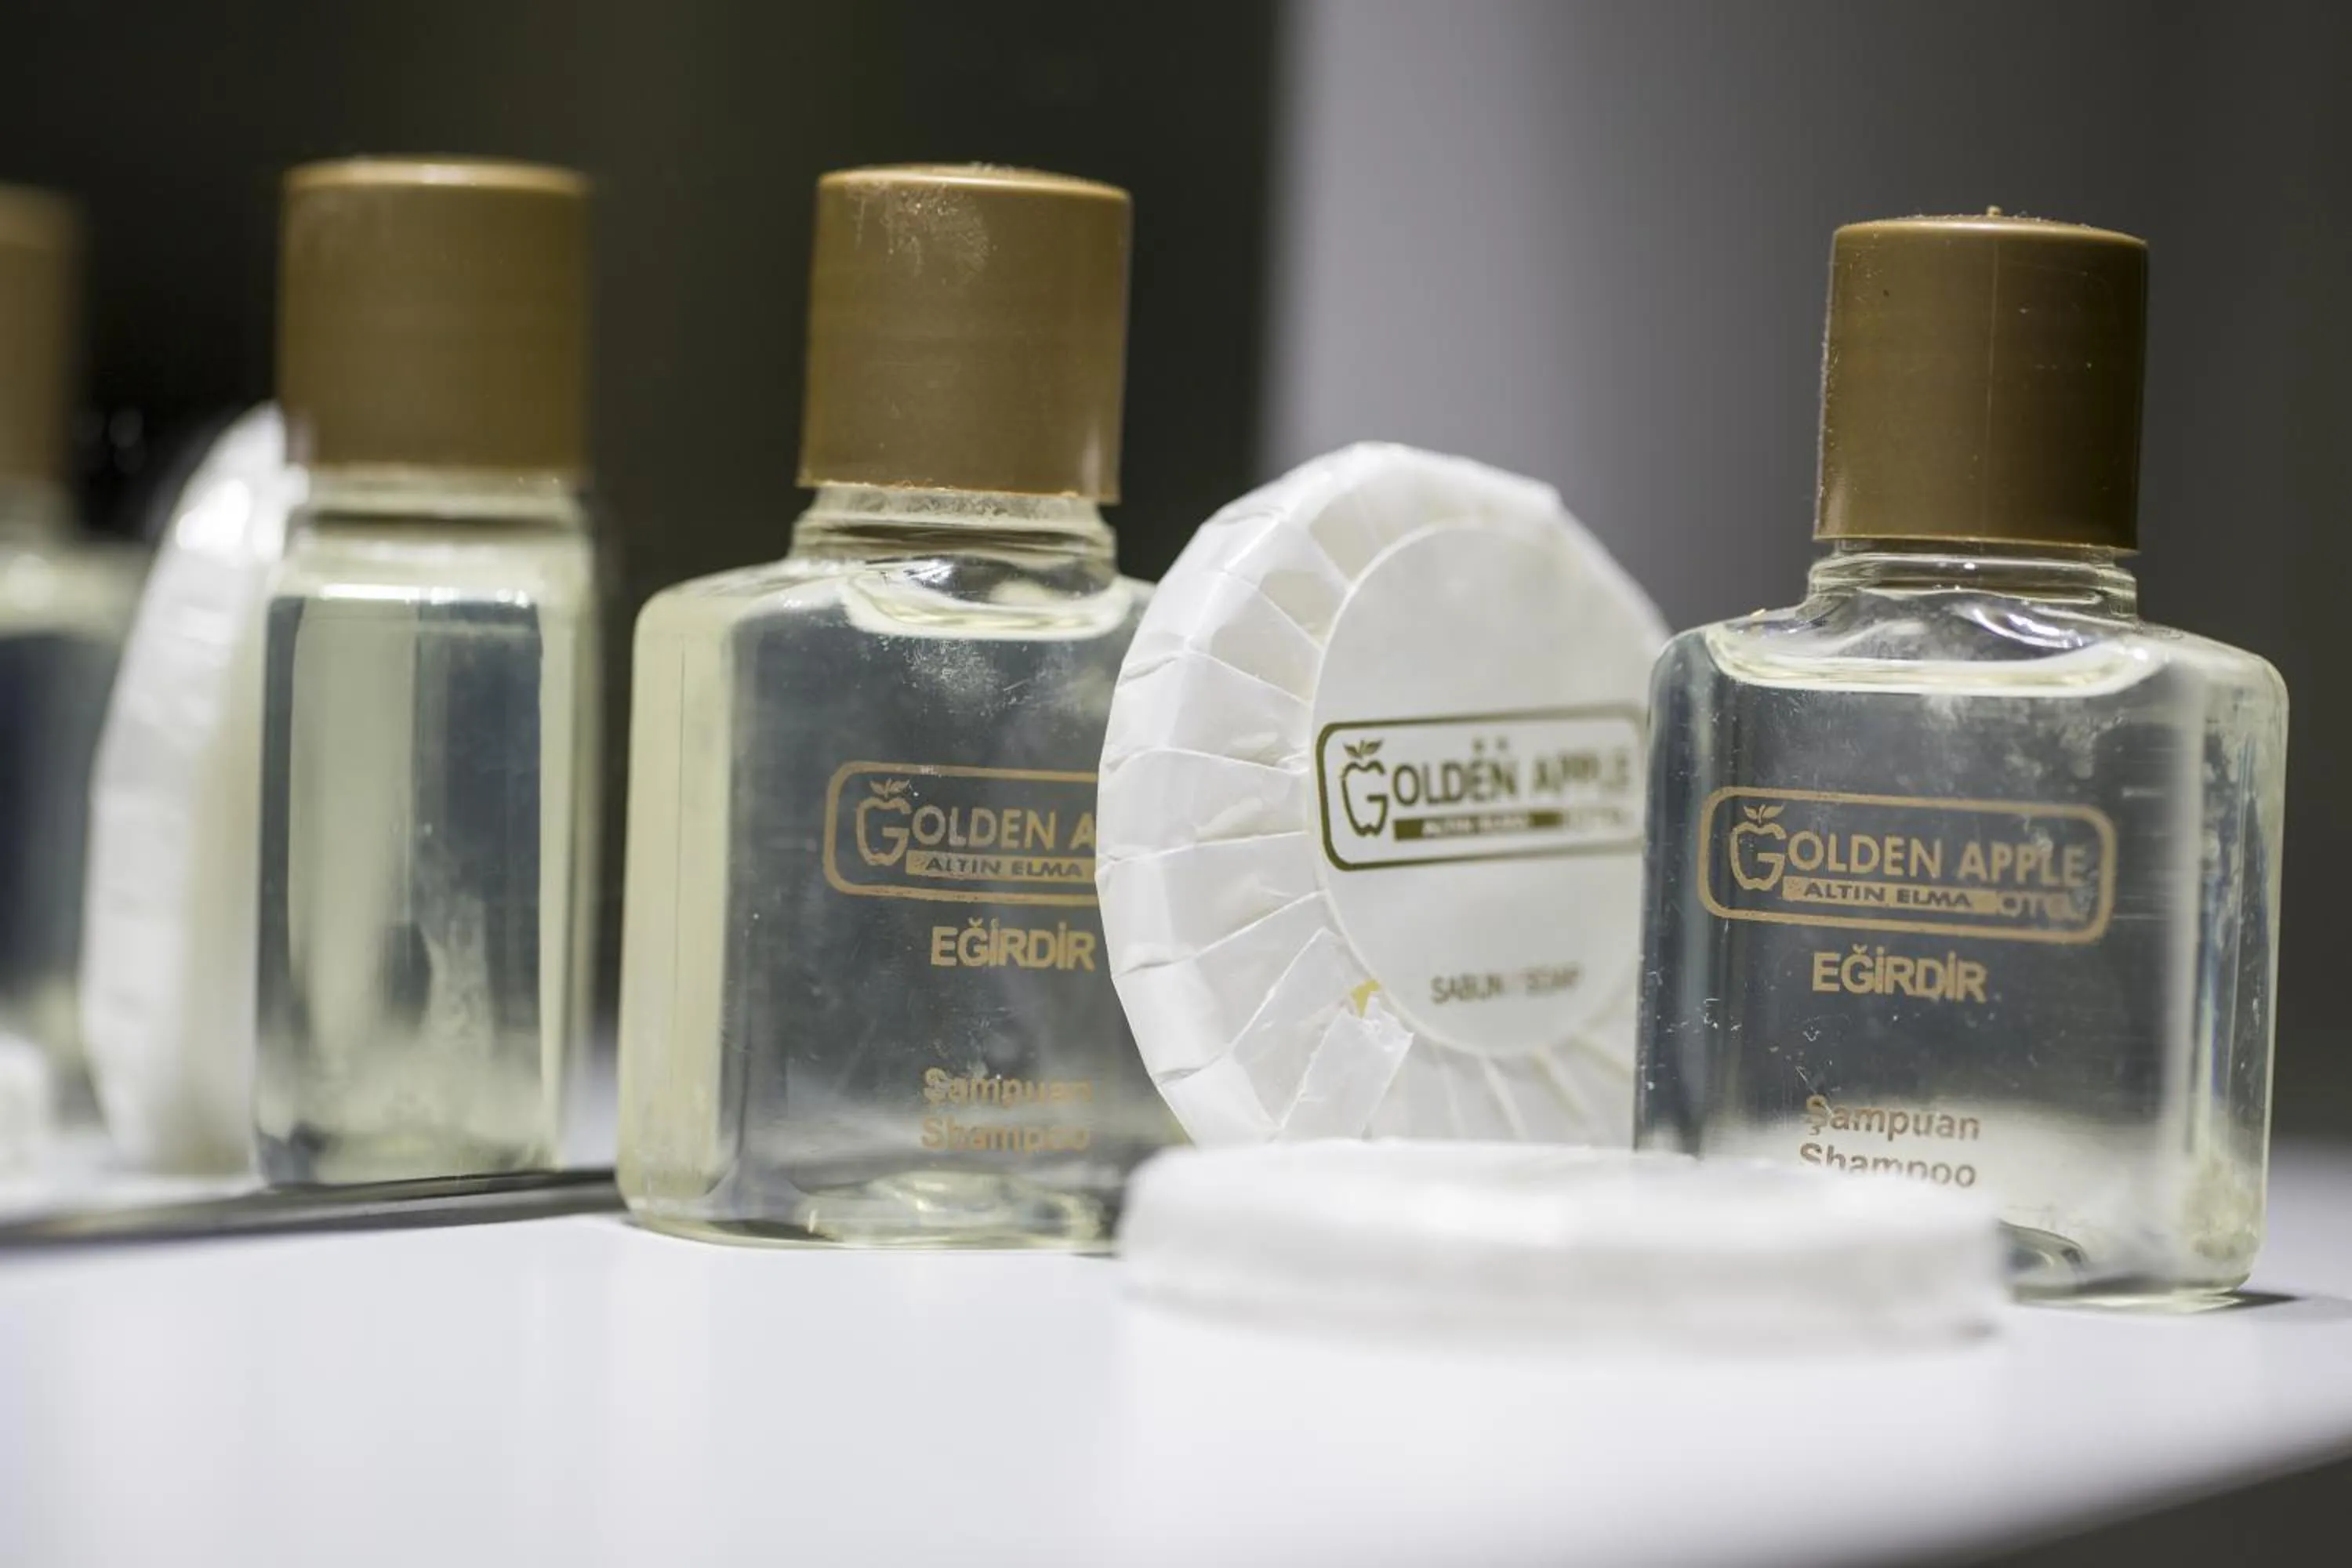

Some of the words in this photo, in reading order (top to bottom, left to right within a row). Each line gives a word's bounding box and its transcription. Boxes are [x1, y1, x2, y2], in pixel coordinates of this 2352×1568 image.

[857, 795, 1056, 866] GOLDEN
[1730, 820, 1942, 891] GOLDEN
[1958, 841, 2087, 888] APPLE
[925, 858, 1000, 877] ALTIN
[1014, 858, 1083, 878] ELMA
[1804, 880, 1886, 902] ALTIN
[1896, 888, 1973, 909] ELMA
[1812, 943, 1987, 1004] EĞİRDİR
[1805, 1094, 1980, 1142] Şampuan
